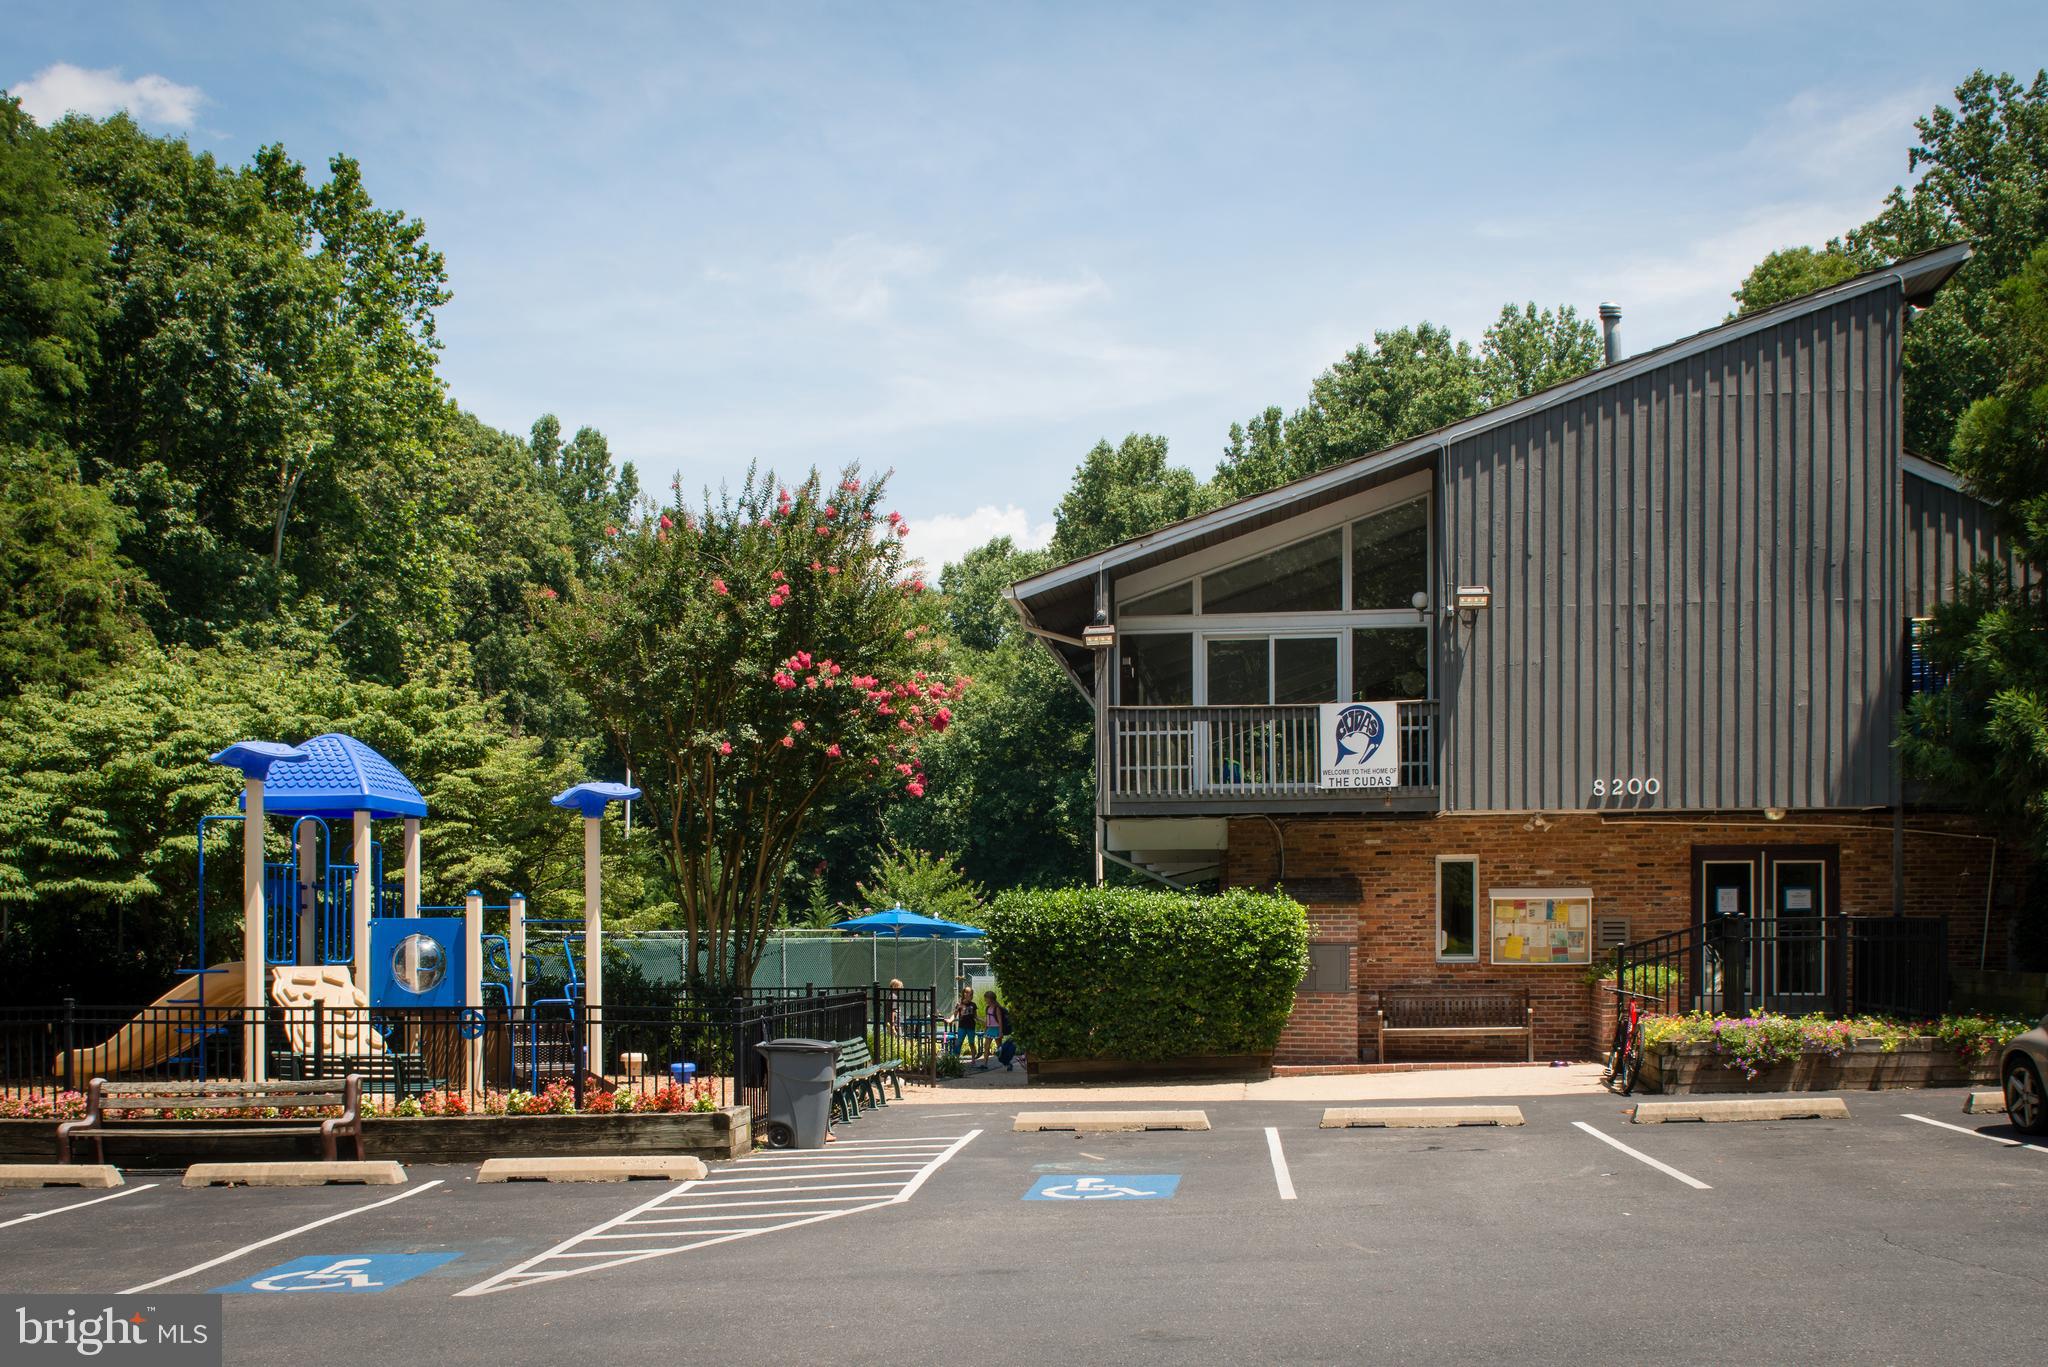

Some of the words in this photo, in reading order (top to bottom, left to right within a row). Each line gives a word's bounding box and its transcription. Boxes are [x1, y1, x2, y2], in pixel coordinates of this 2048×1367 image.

[1336, 709, 1378, 740] CUDAS
[1322, 768, 1350, 776] WELCOME
[1328, 777, 1350, 787] THE
[1354, 776, 1392, 787] CUDAS
[1593, 778, 1660, 796] 8200
